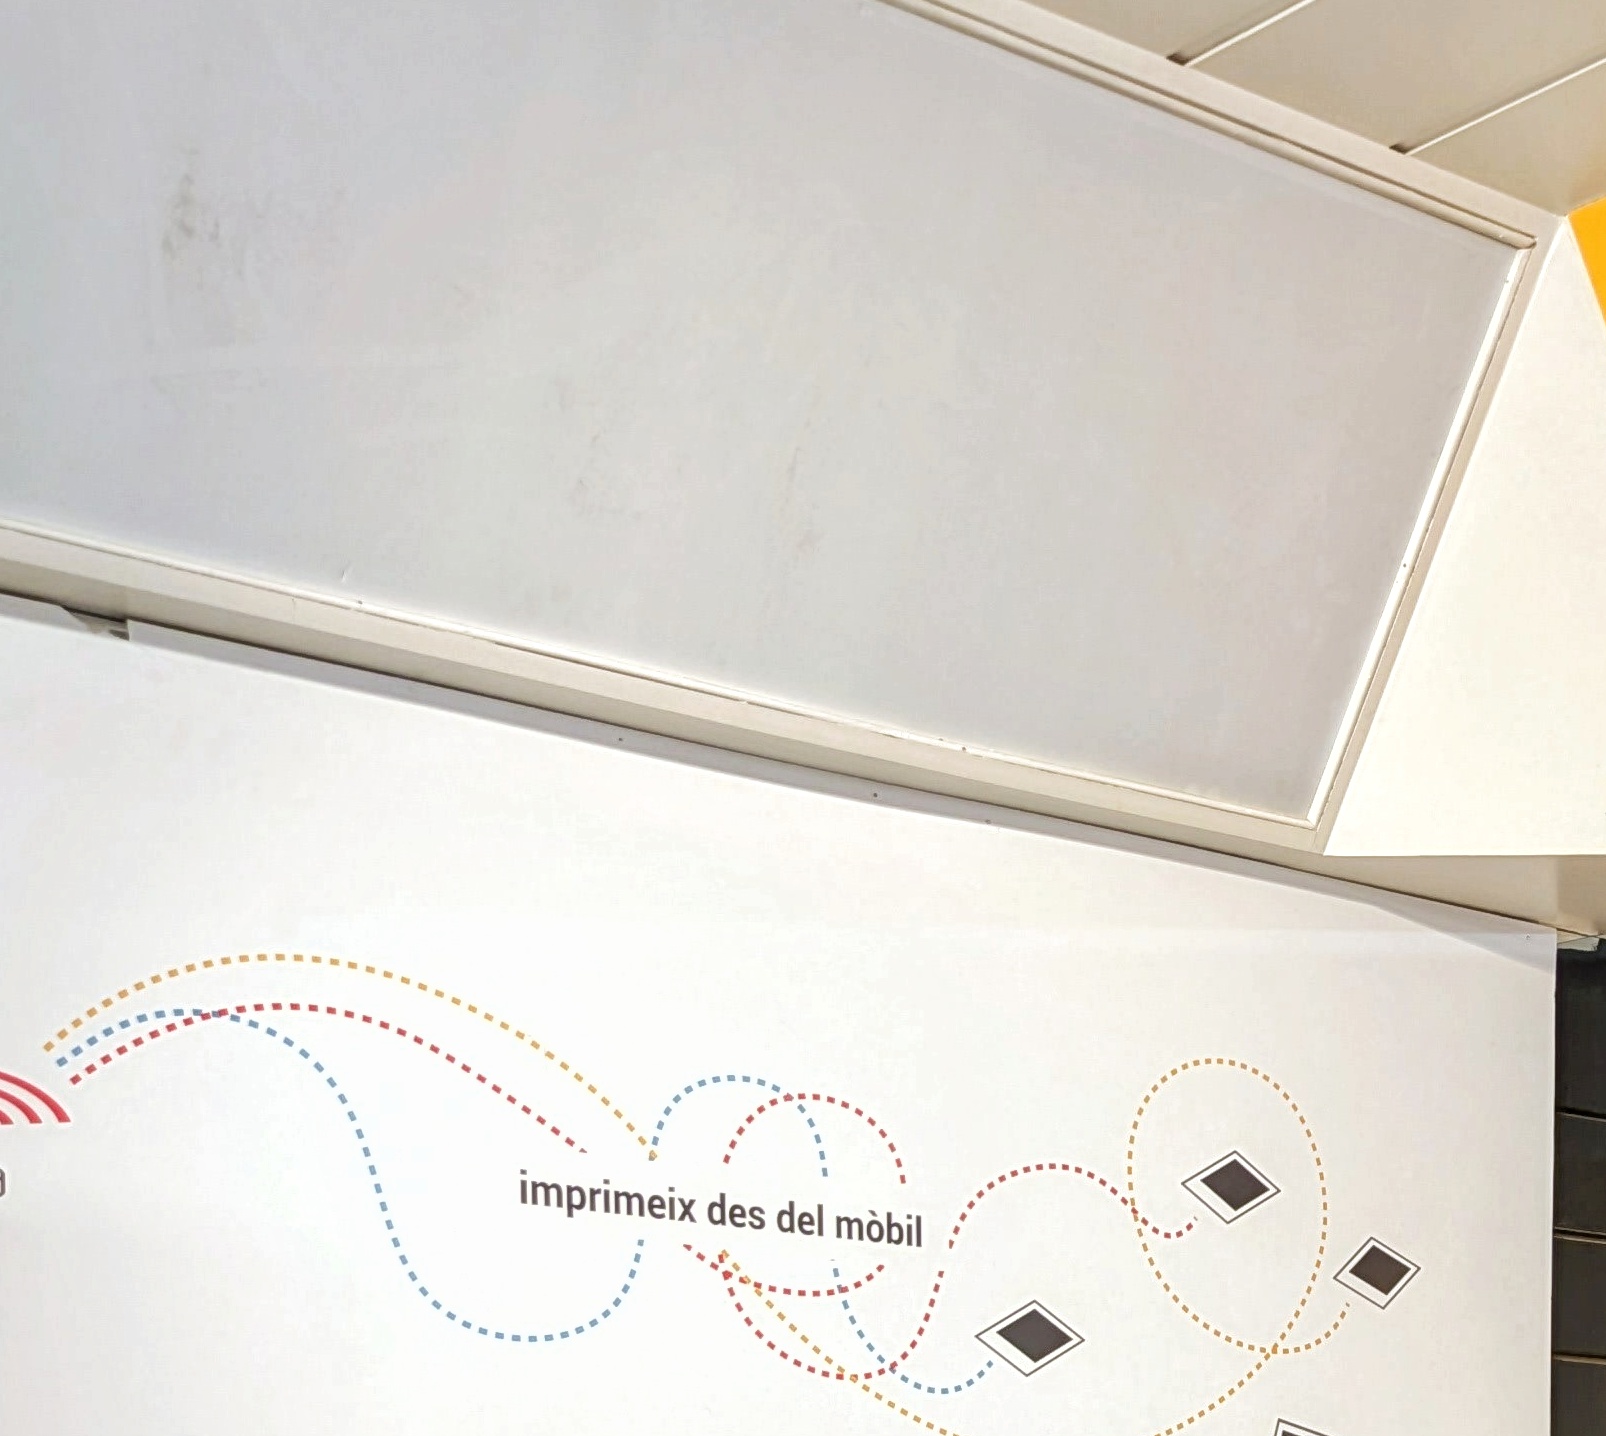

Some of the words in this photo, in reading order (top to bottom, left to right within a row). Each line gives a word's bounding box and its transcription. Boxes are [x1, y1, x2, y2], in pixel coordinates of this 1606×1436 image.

[519, 1168, 697, 1226] imprimeix
[706, 1192, 768, 1235] des
[775, 1200, 826, 1238] del
[834, 1209, 924, 1248] mòbil
